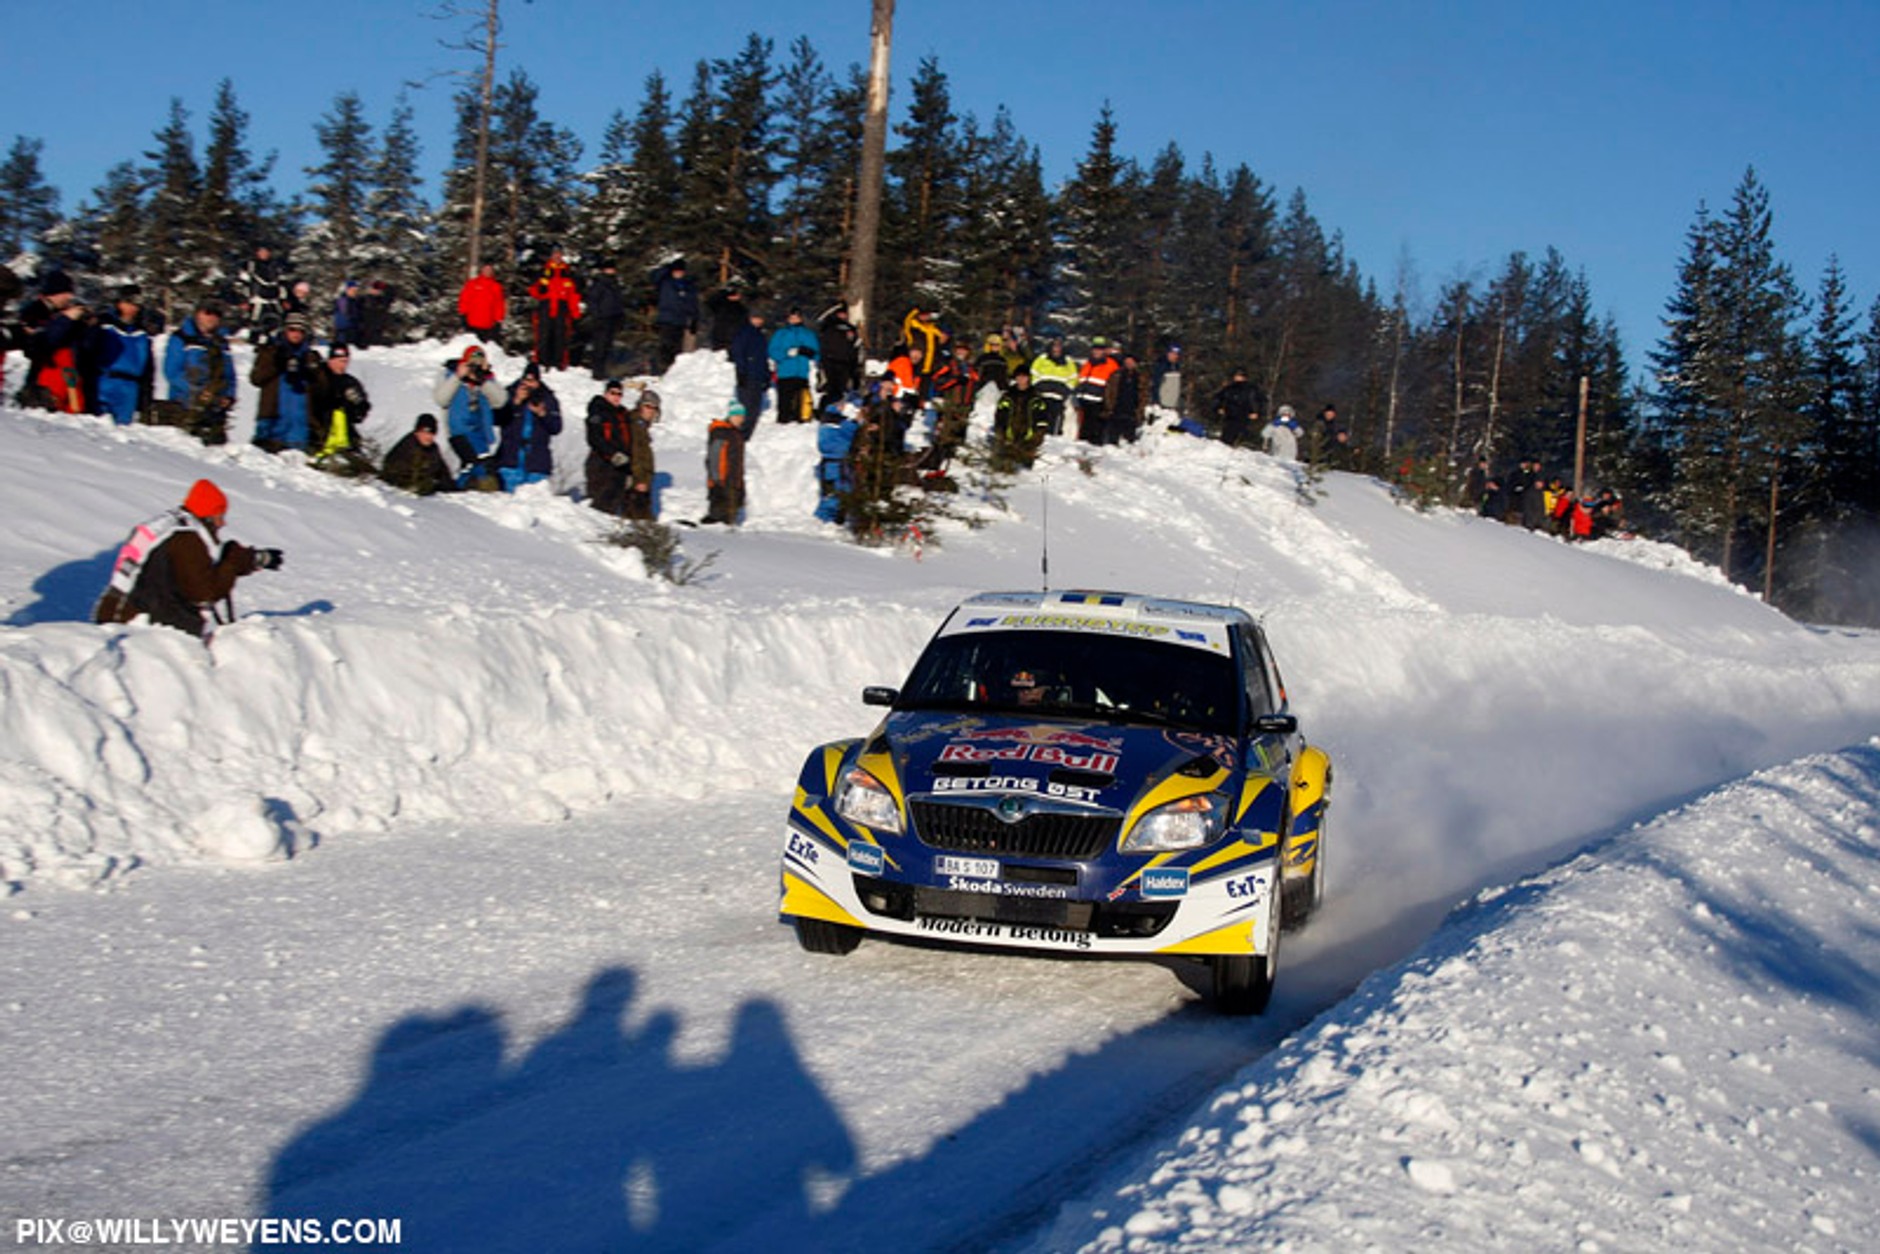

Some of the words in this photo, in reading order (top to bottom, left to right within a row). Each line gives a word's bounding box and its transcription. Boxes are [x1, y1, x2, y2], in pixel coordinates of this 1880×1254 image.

[938, 744, 1030, 762] Red
[1030, 744, 1119, 773] Bull
[1146, 876, 1186, 890] Haldex
